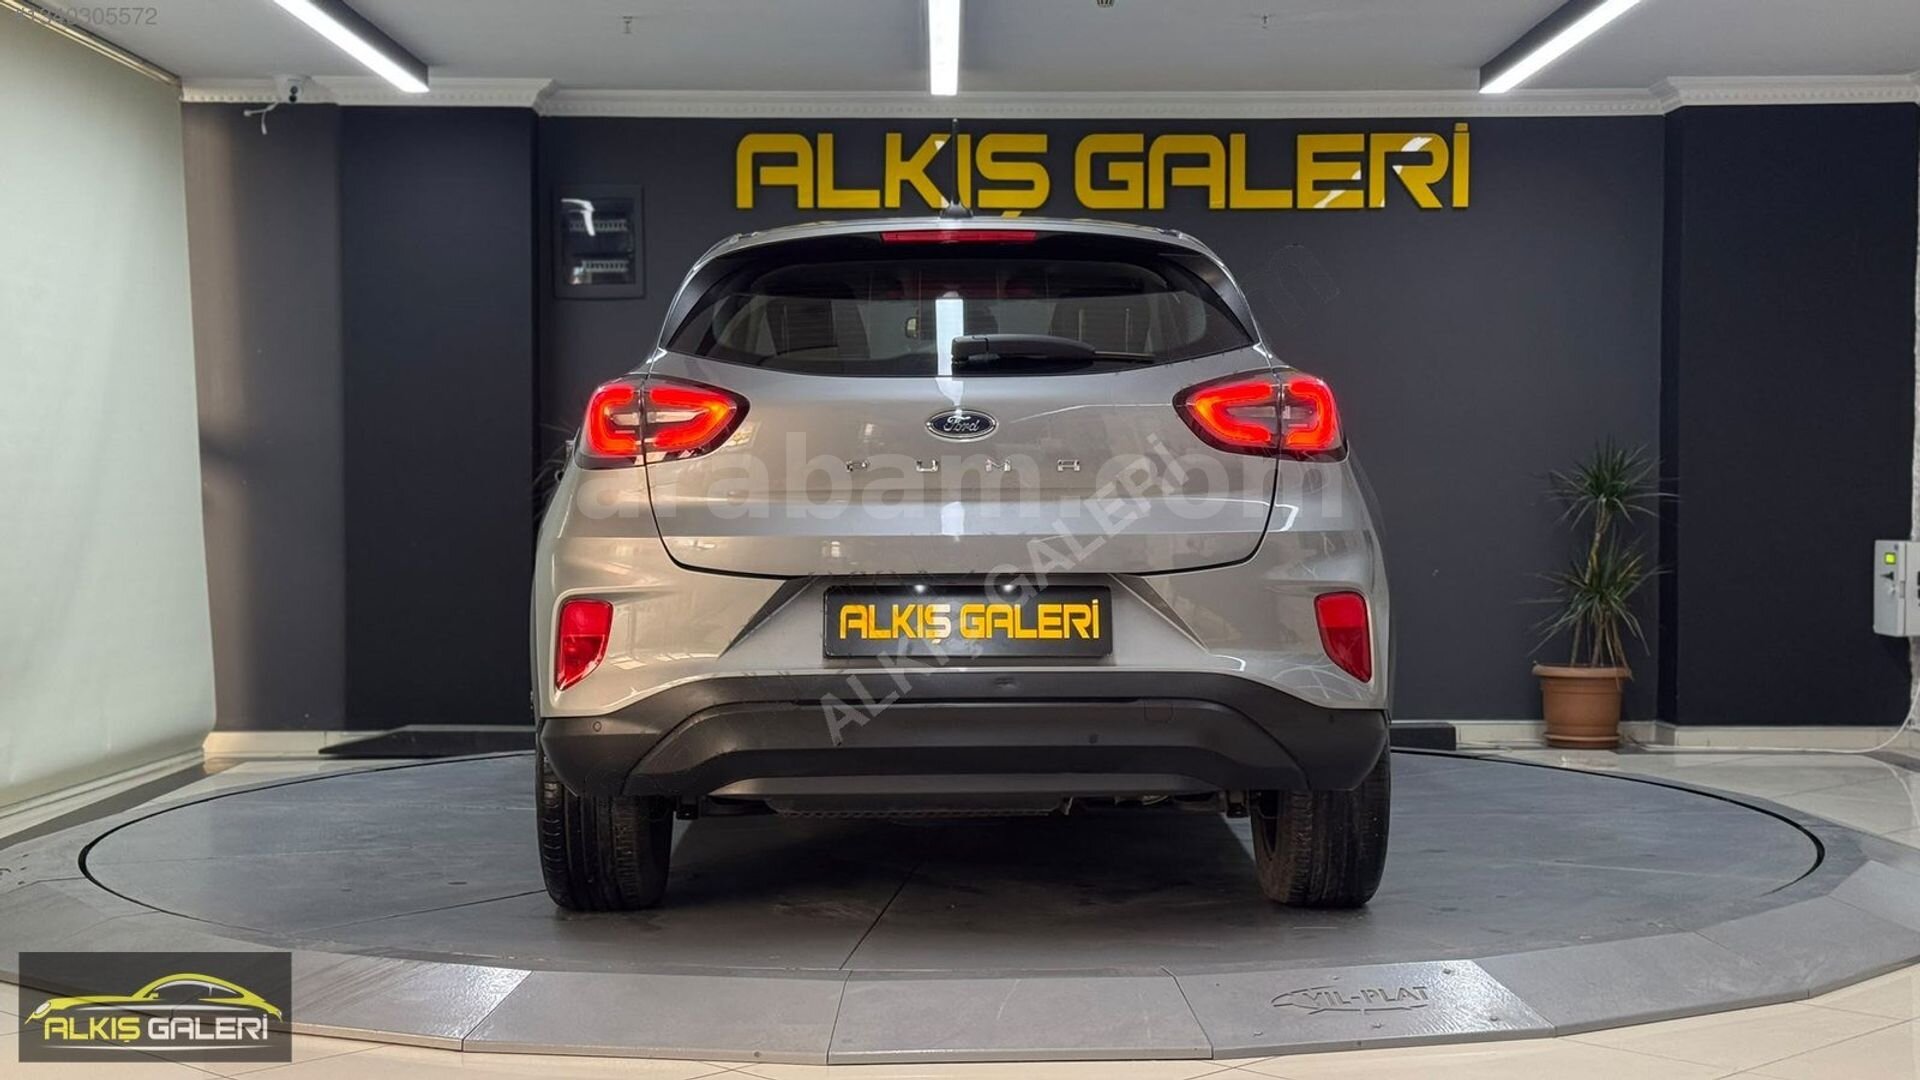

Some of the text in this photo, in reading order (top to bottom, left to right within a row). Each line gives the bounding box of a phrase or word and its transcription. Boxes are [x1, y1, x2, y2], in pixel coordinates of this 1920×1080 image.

[736, 122, 1470, 218] ALKIŞ GALERİ
[943, 414, 980, 433] Ford
[839, 598, 1100, 644] ALKIŞ GALERİ
